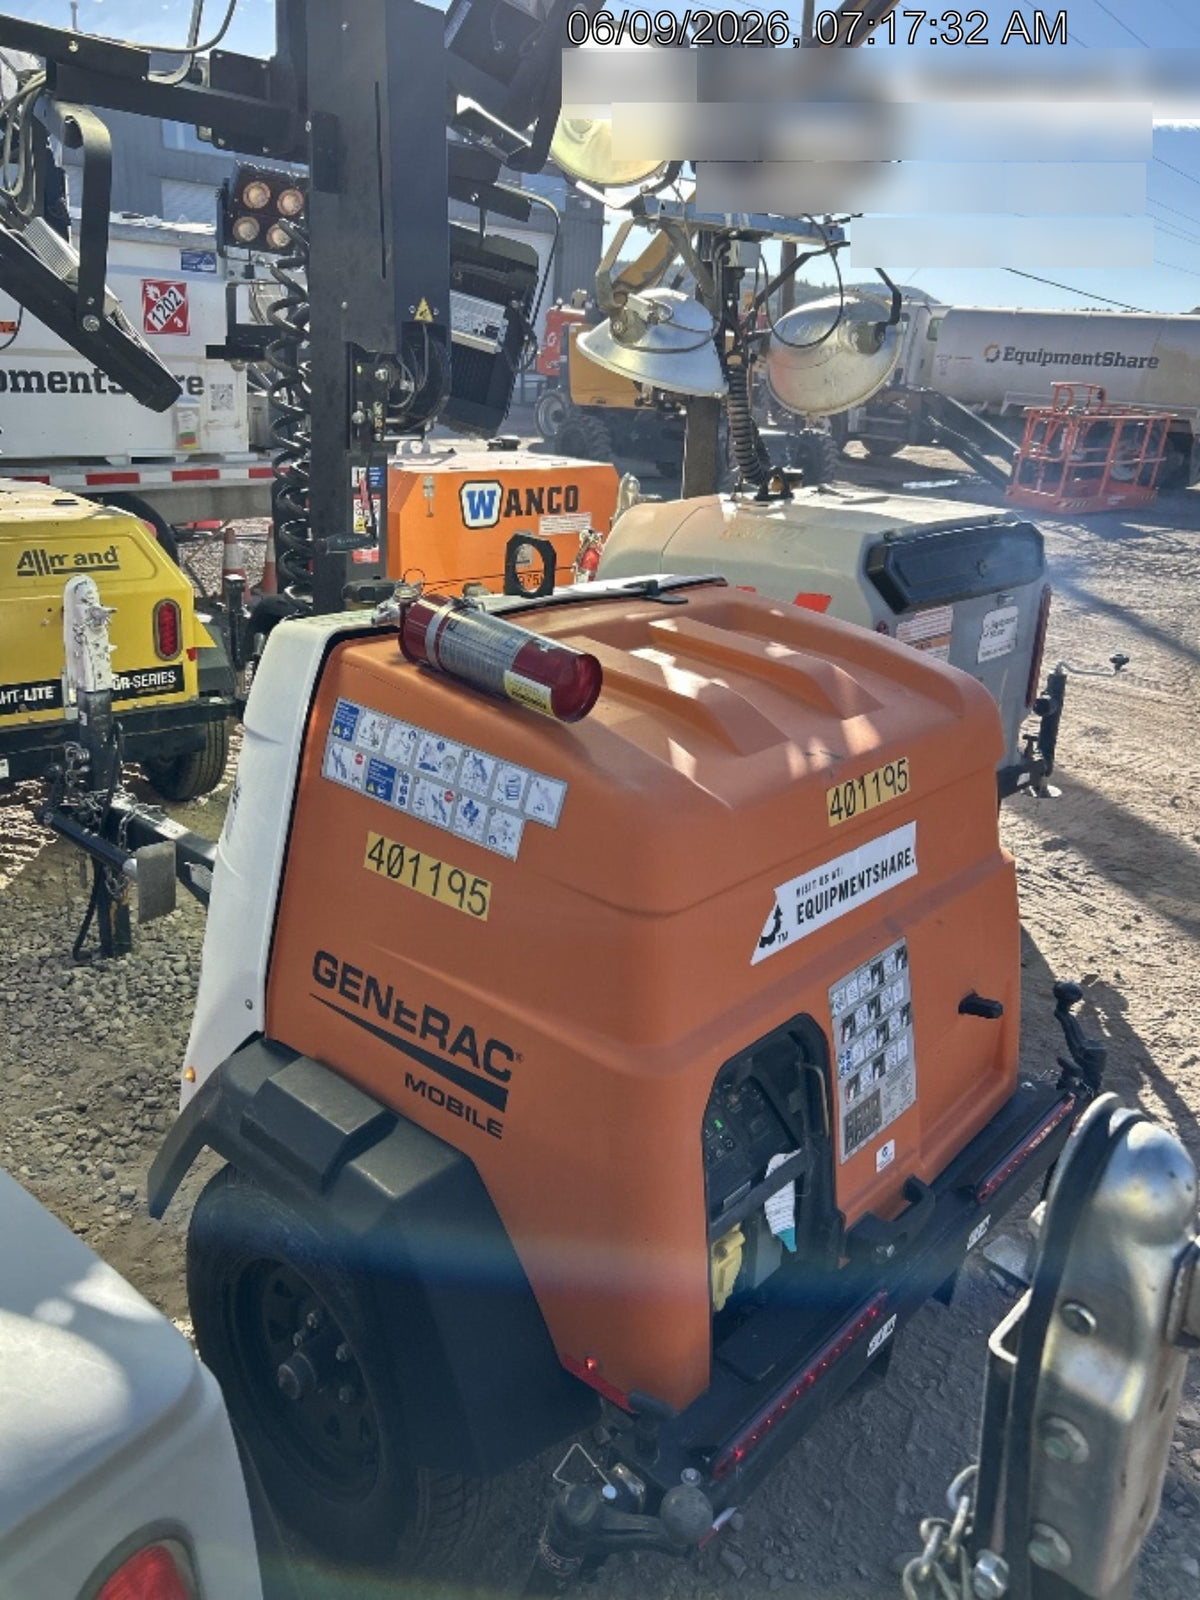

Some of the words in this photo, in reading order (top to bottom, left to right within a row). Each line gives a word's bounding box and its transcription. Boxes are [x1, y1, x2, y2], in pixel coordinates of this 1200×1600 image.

[151, 288, 183, 327] 1202
[1002, 345, 1159, 370] EquipmentShare
[465, 484, 580, 521] WANCO
[830, 759, 908, 821] 401195
[366, 836, 490, 918] 401195
[796, 847, 916, 926] EQUIPMENTSHARE.
[311, 949, 515, 1083] GENERAC
[404, 1072, 505, 1140] MOBILE
